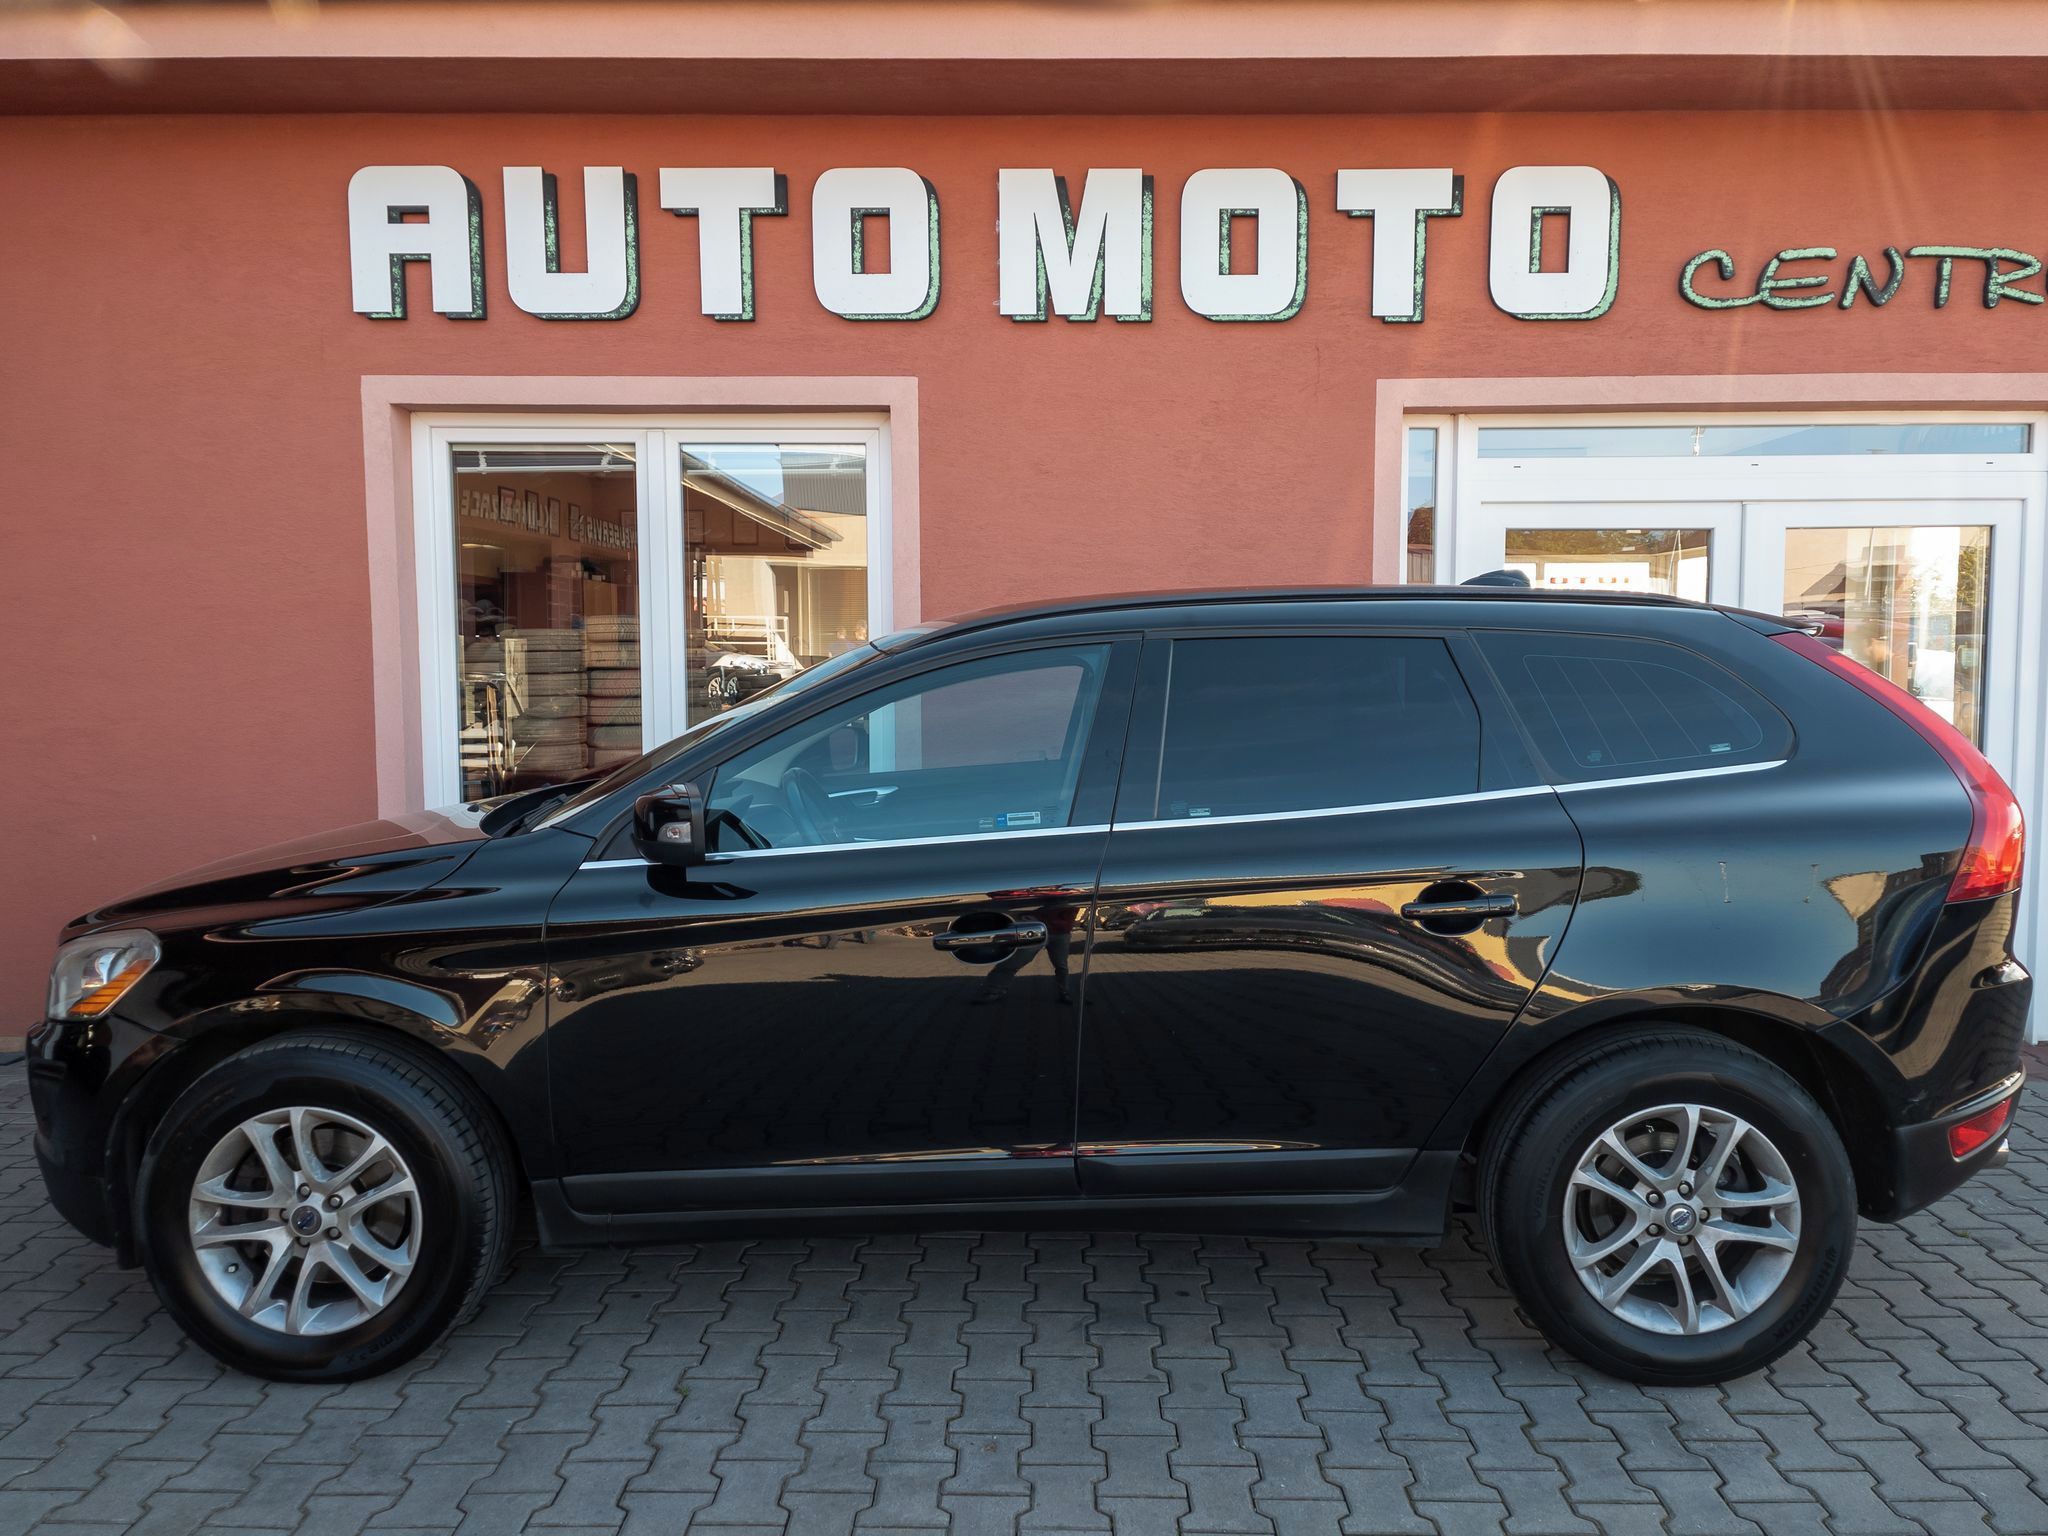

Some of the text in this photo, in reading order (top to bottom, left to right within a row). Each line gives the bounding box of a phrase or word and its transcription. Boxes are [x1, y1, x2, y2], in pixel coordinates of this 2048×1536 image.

[347, 165, 2048, 322] AUTO MOTO CENTR
